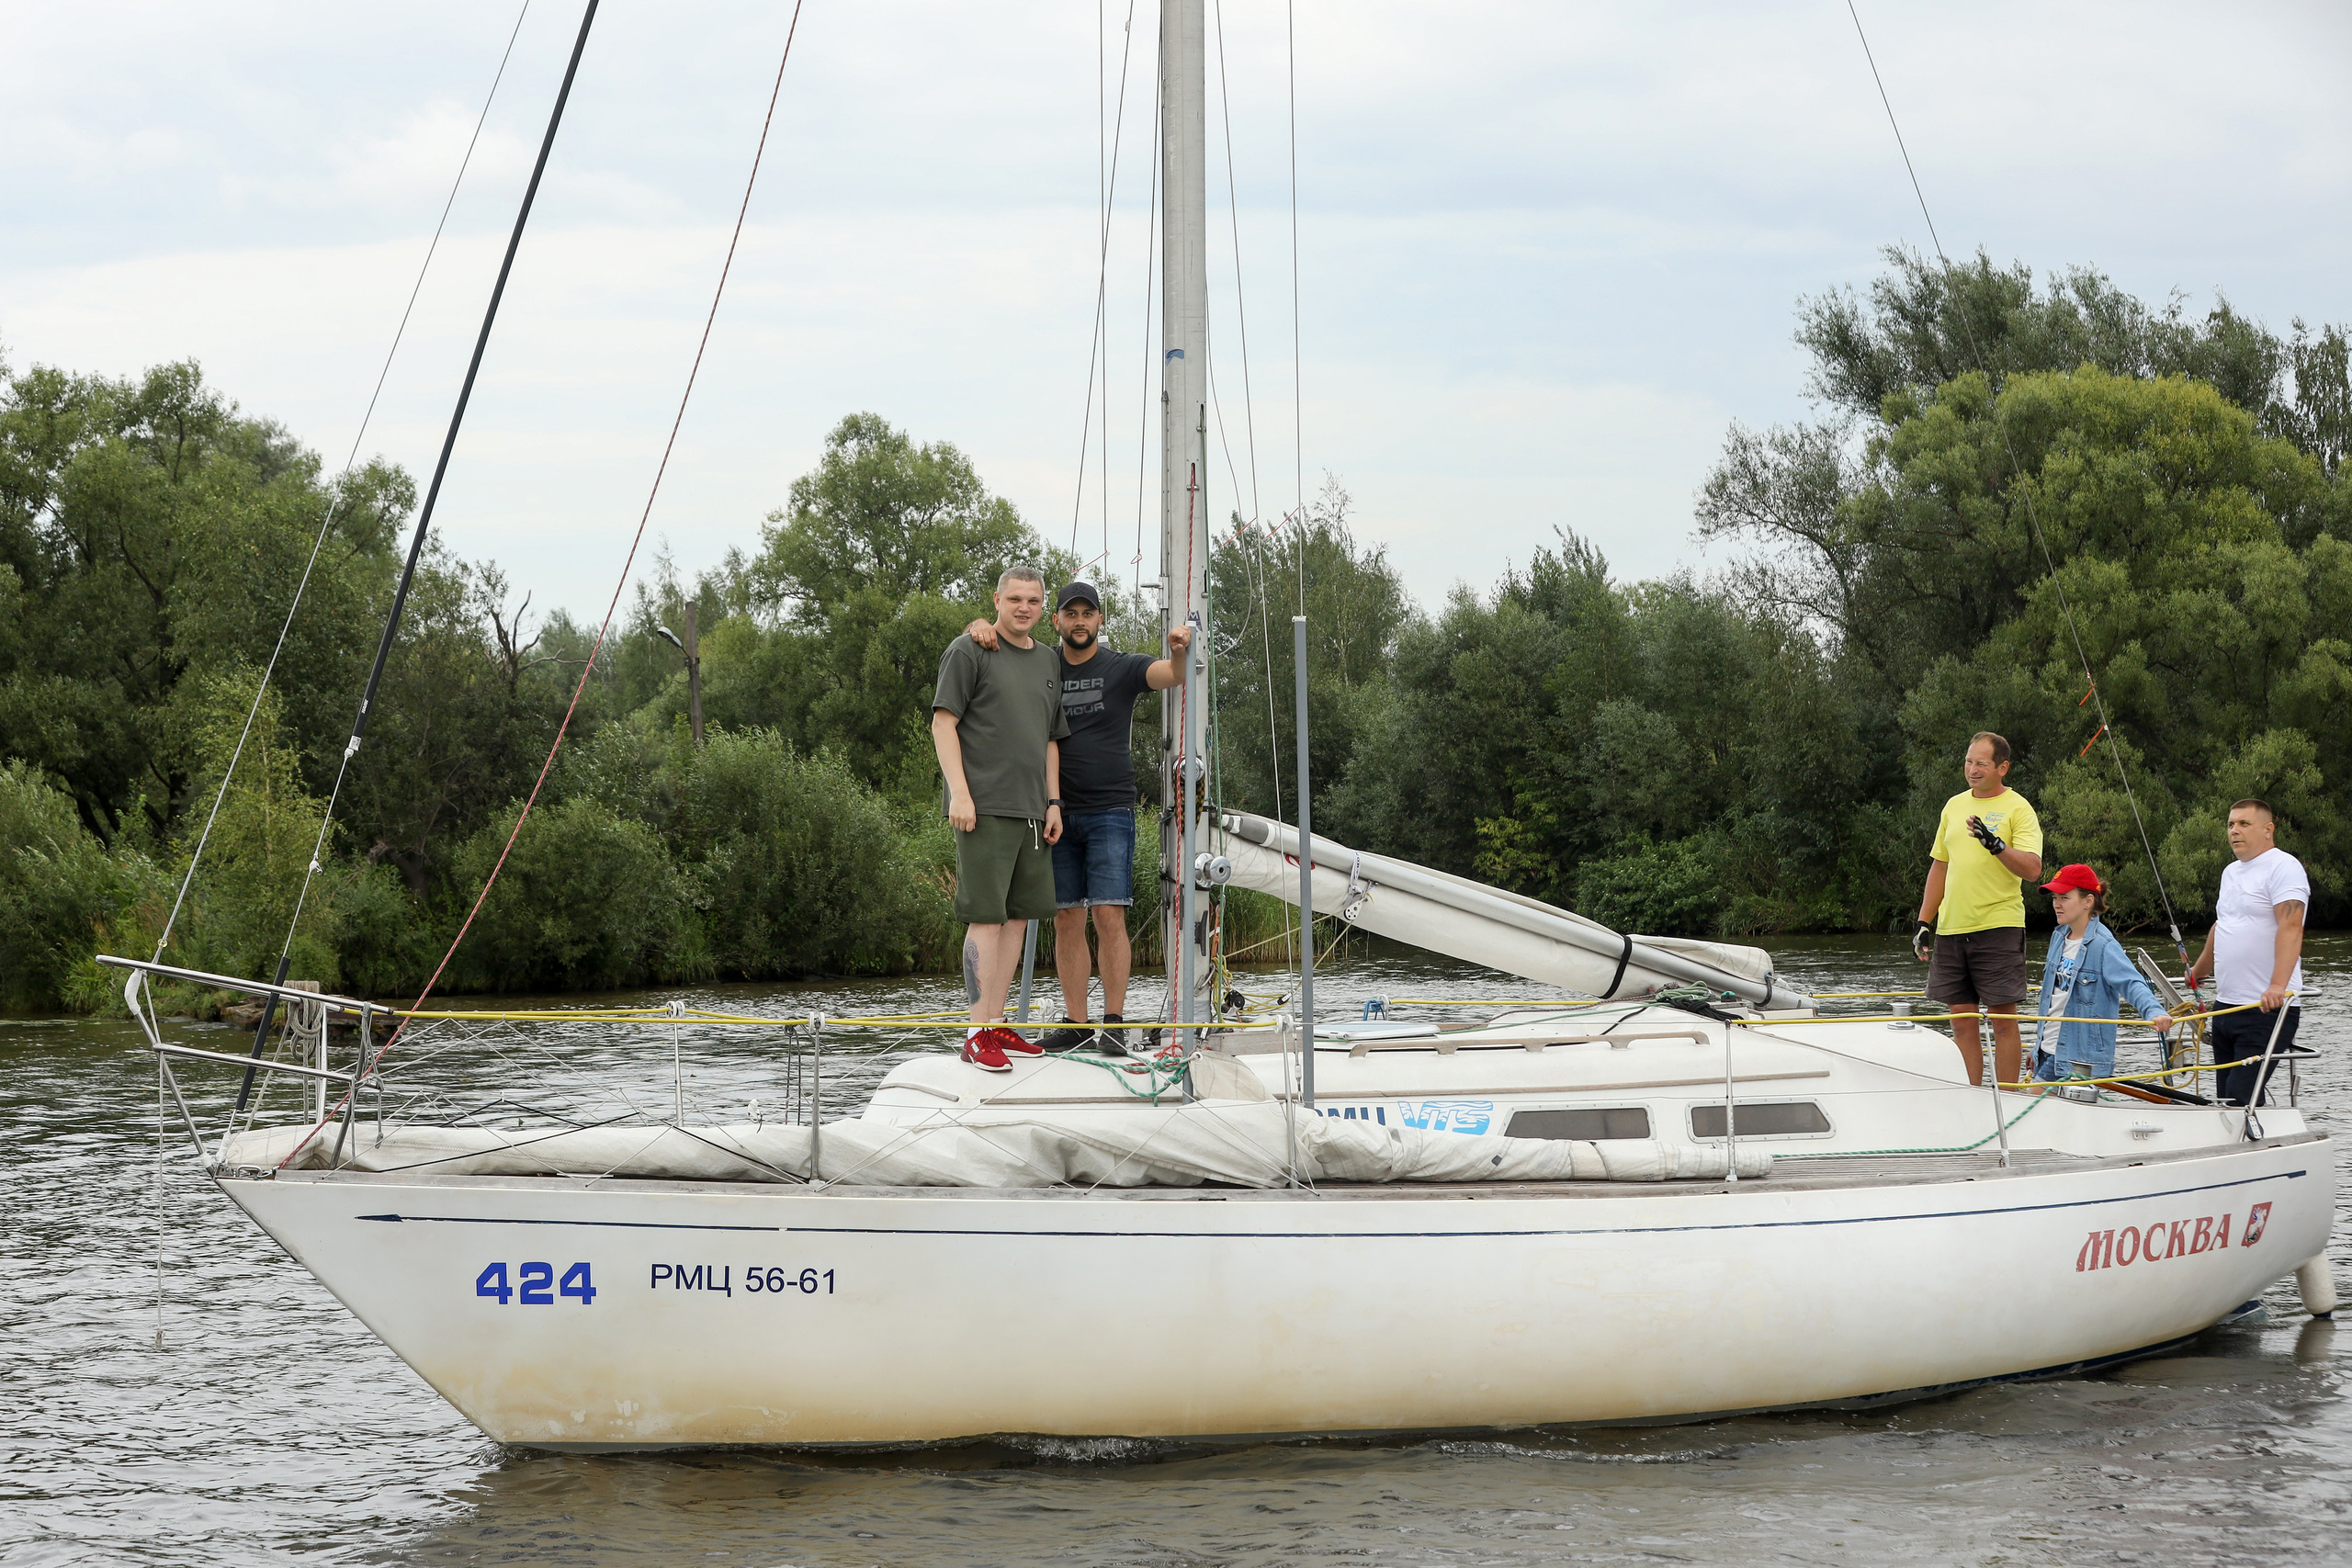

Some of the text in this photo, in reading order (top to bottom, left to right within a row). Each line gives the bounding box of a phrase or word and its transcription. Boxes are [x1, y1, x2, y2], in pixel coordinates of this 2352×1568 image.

[2075, 1213, 2232, 1273] МОСКВА
[475, 1262, 597, 1305] 424
[650, 1263, 835, 1297] РМЦ 56-61
